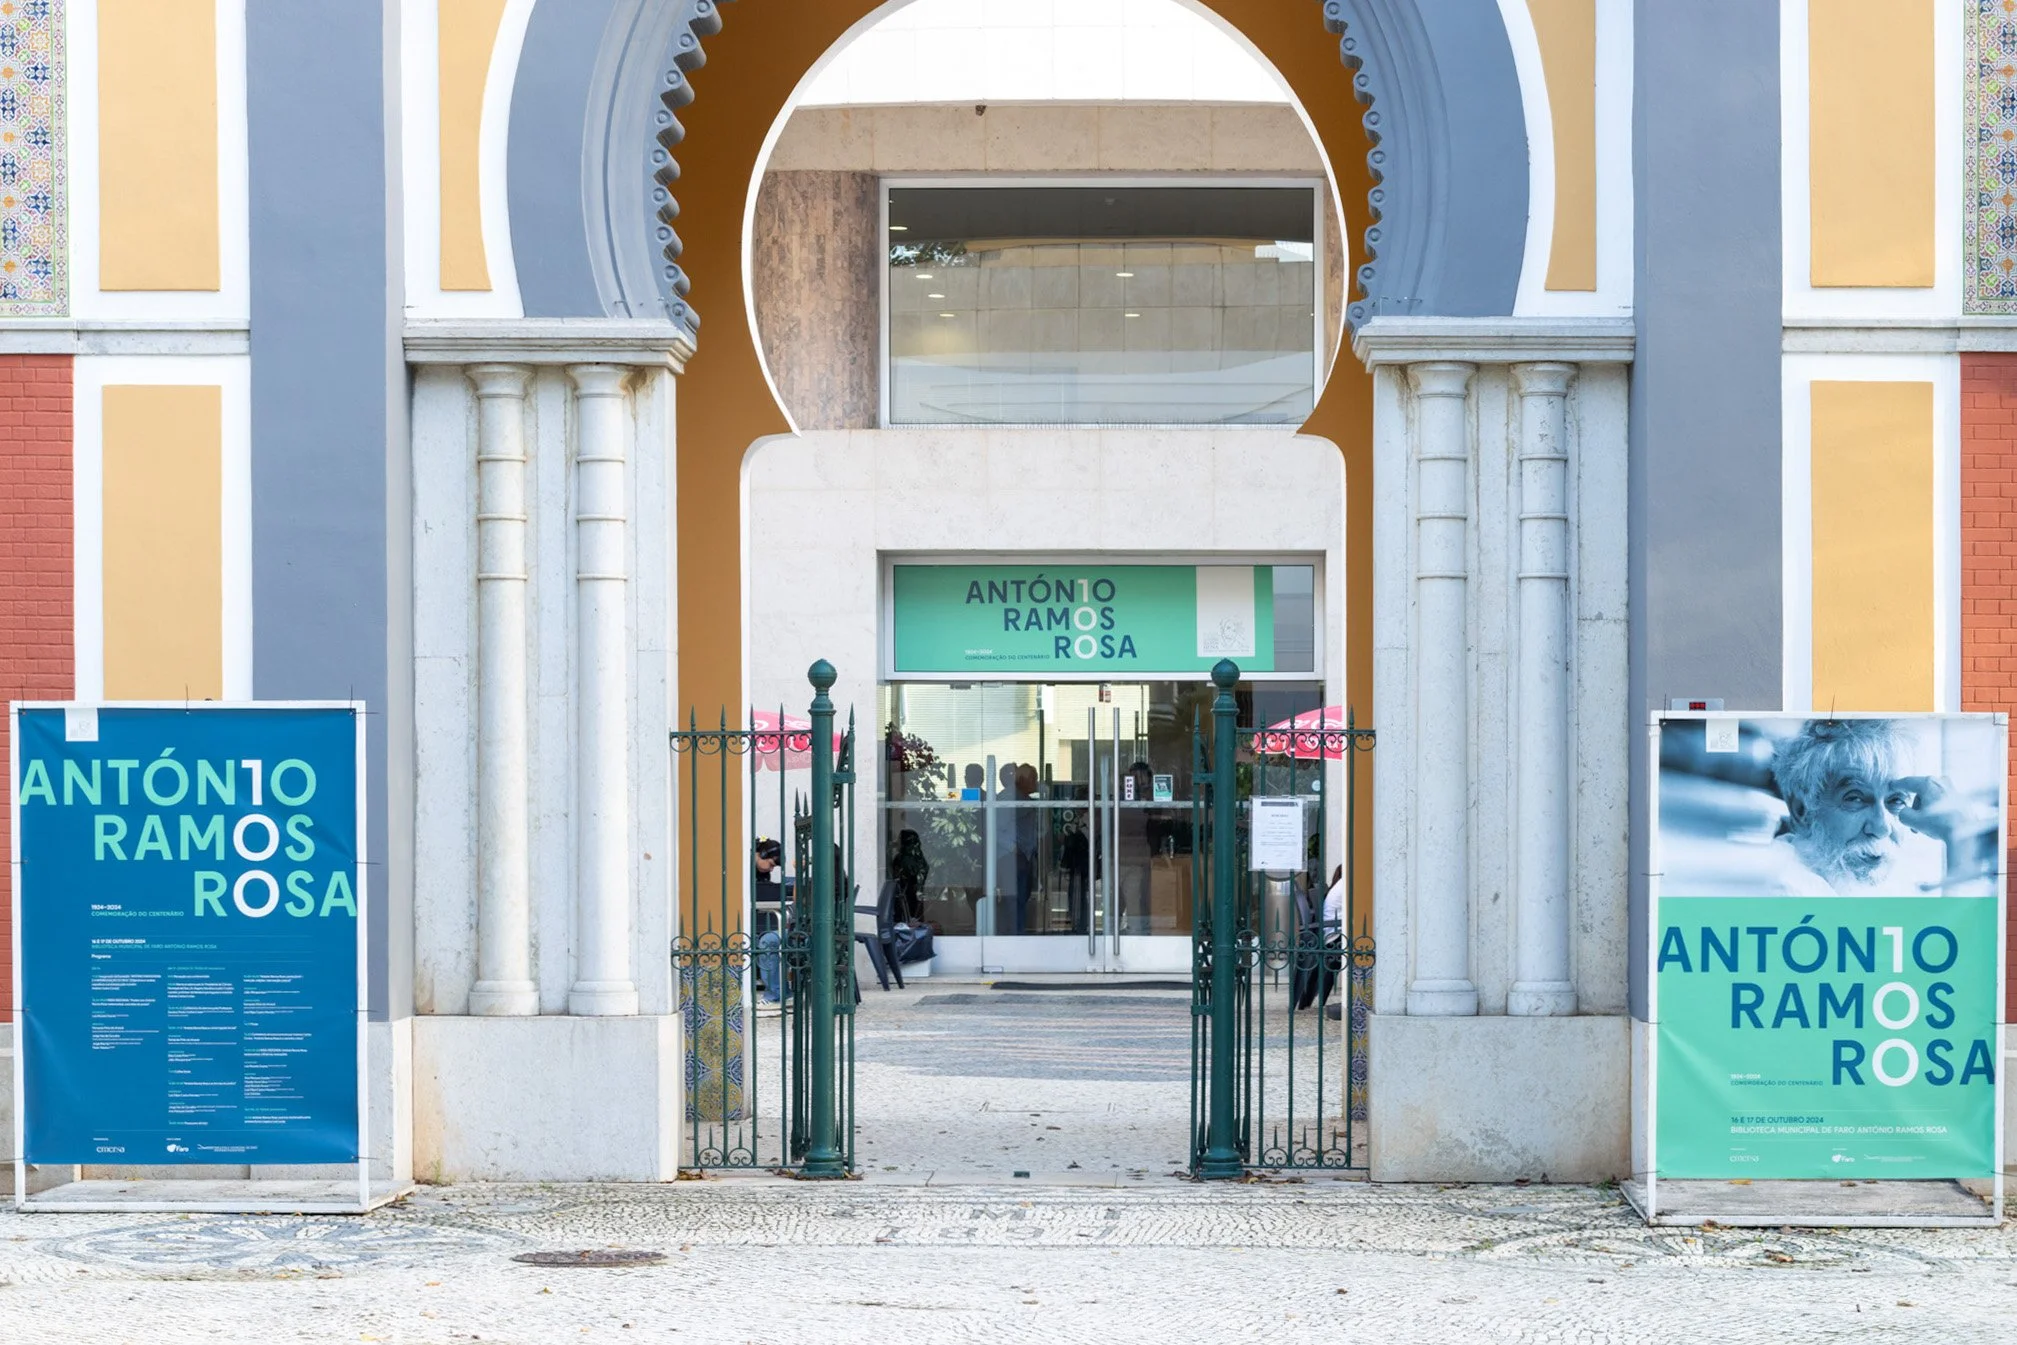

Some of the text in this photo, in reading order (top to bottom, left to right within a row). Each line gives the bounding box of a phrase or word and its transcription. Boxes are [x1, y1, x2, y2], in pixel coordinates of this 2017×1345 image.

[1004, 606, 1116, 632] RAMOS
[1054, 634, 1138, 660] ROSA
[94, 814, 316, 862] RAMOS
[194, 870, 358, 919] ROSA
[1730, 981, 1955, 1030] RAMOS
[1831, 1038, 1996, 1087] ROSA
[1730, 1079, 1777, 1087] COMEMORAÇÃO
[1731, 1125, 1948, 1134] BIBLIOTECA MUNICIPAL DE FARO ANTÓNIO RAMOS ROSA
